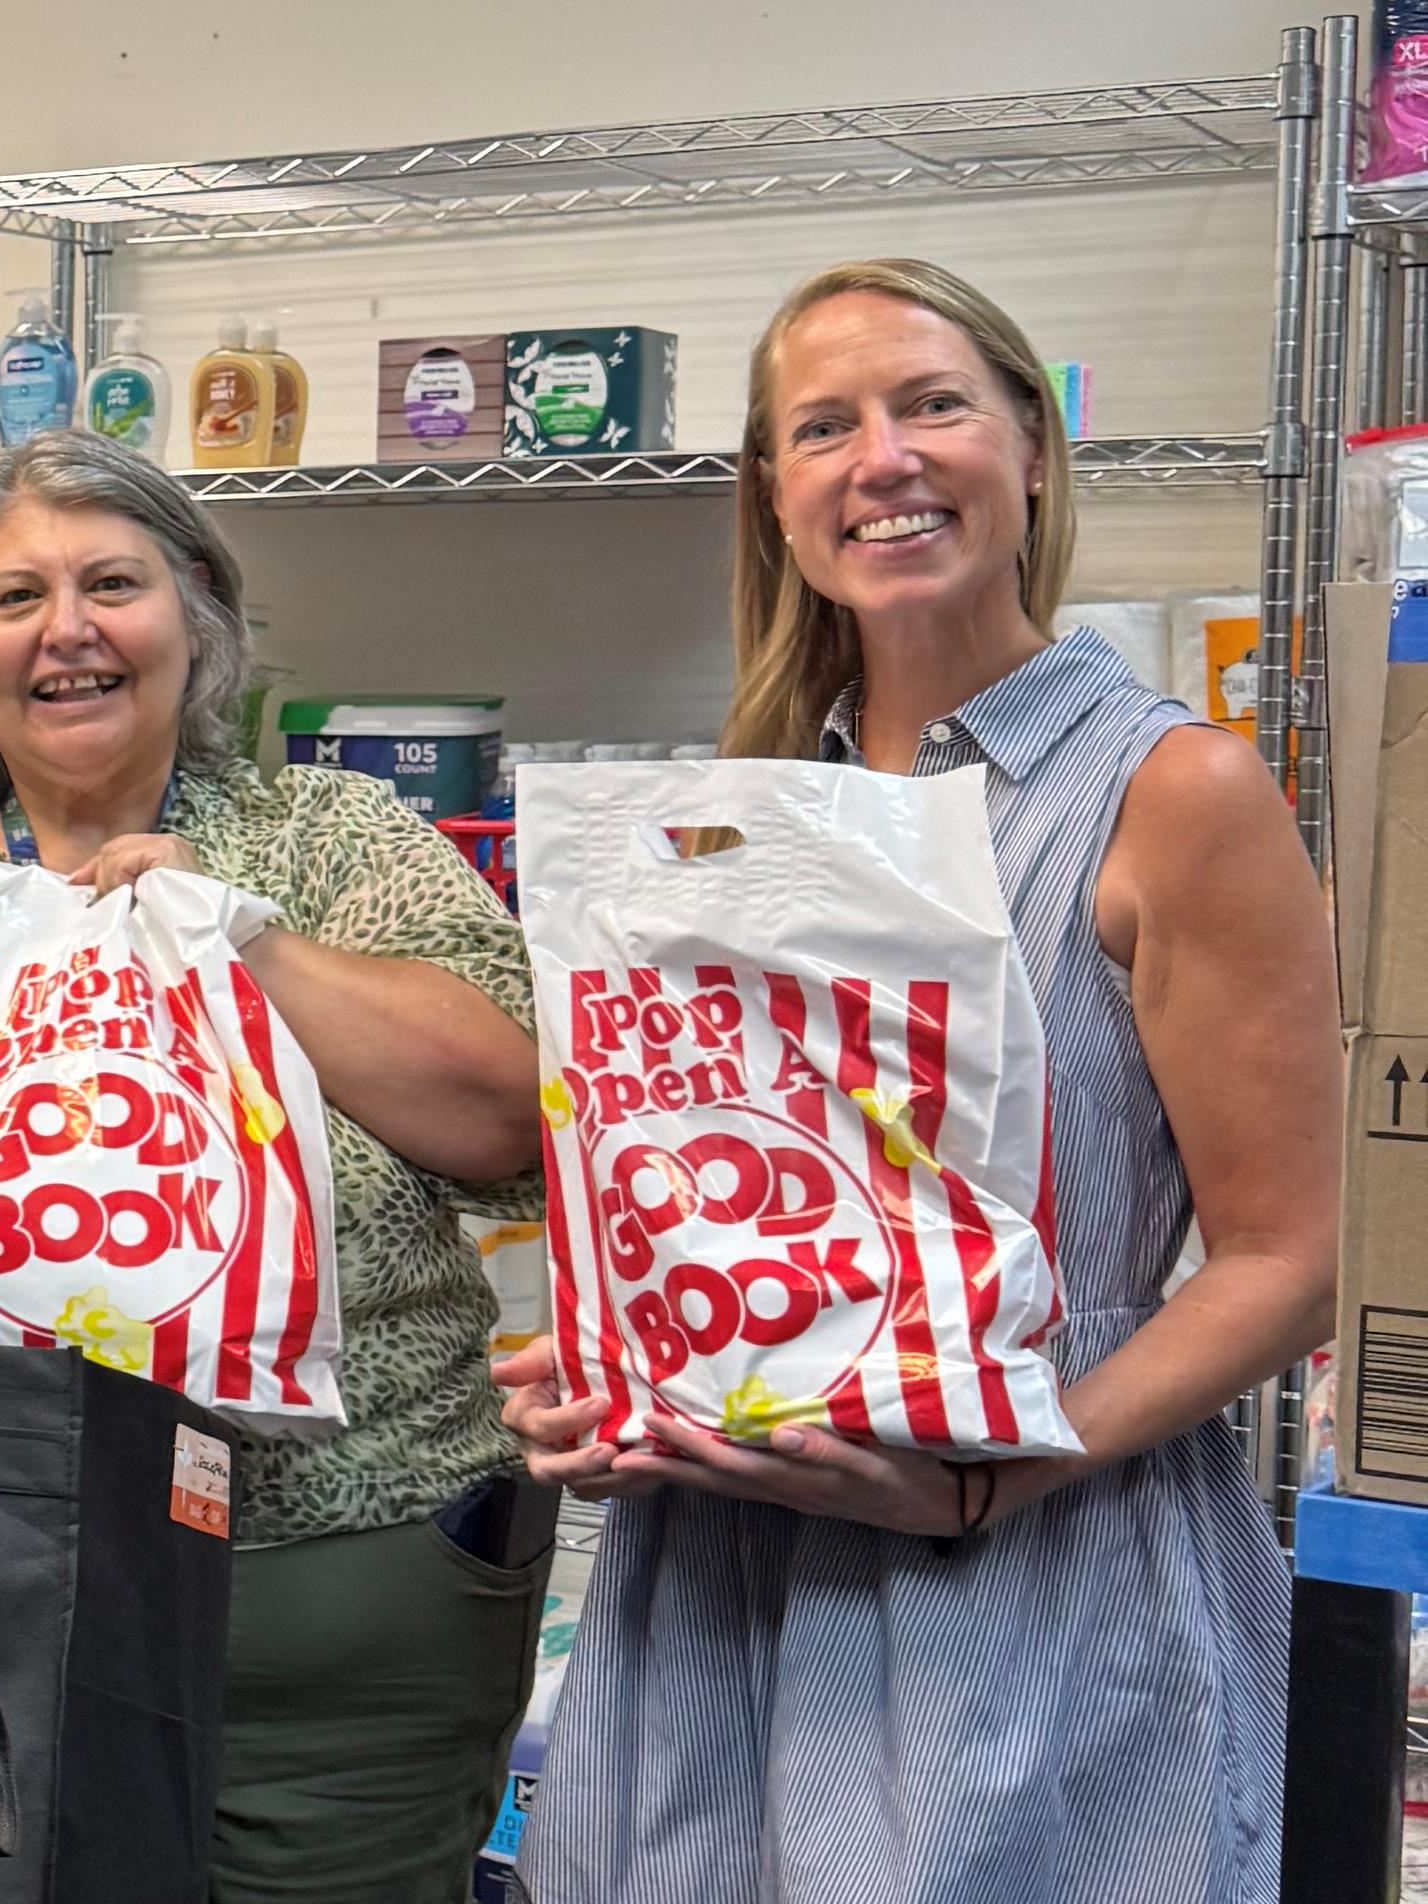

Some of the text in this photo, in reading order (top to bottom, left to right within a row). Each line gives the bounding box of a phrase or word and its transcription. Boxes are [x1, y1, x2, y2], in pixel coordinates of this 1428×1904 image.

[394, 742, 437, 764] 105
[394, 764, 437, 774] COUNT
[601, 1132, 836, 1281] GOOD
[624, 1238, 884, 1386] BOOK
